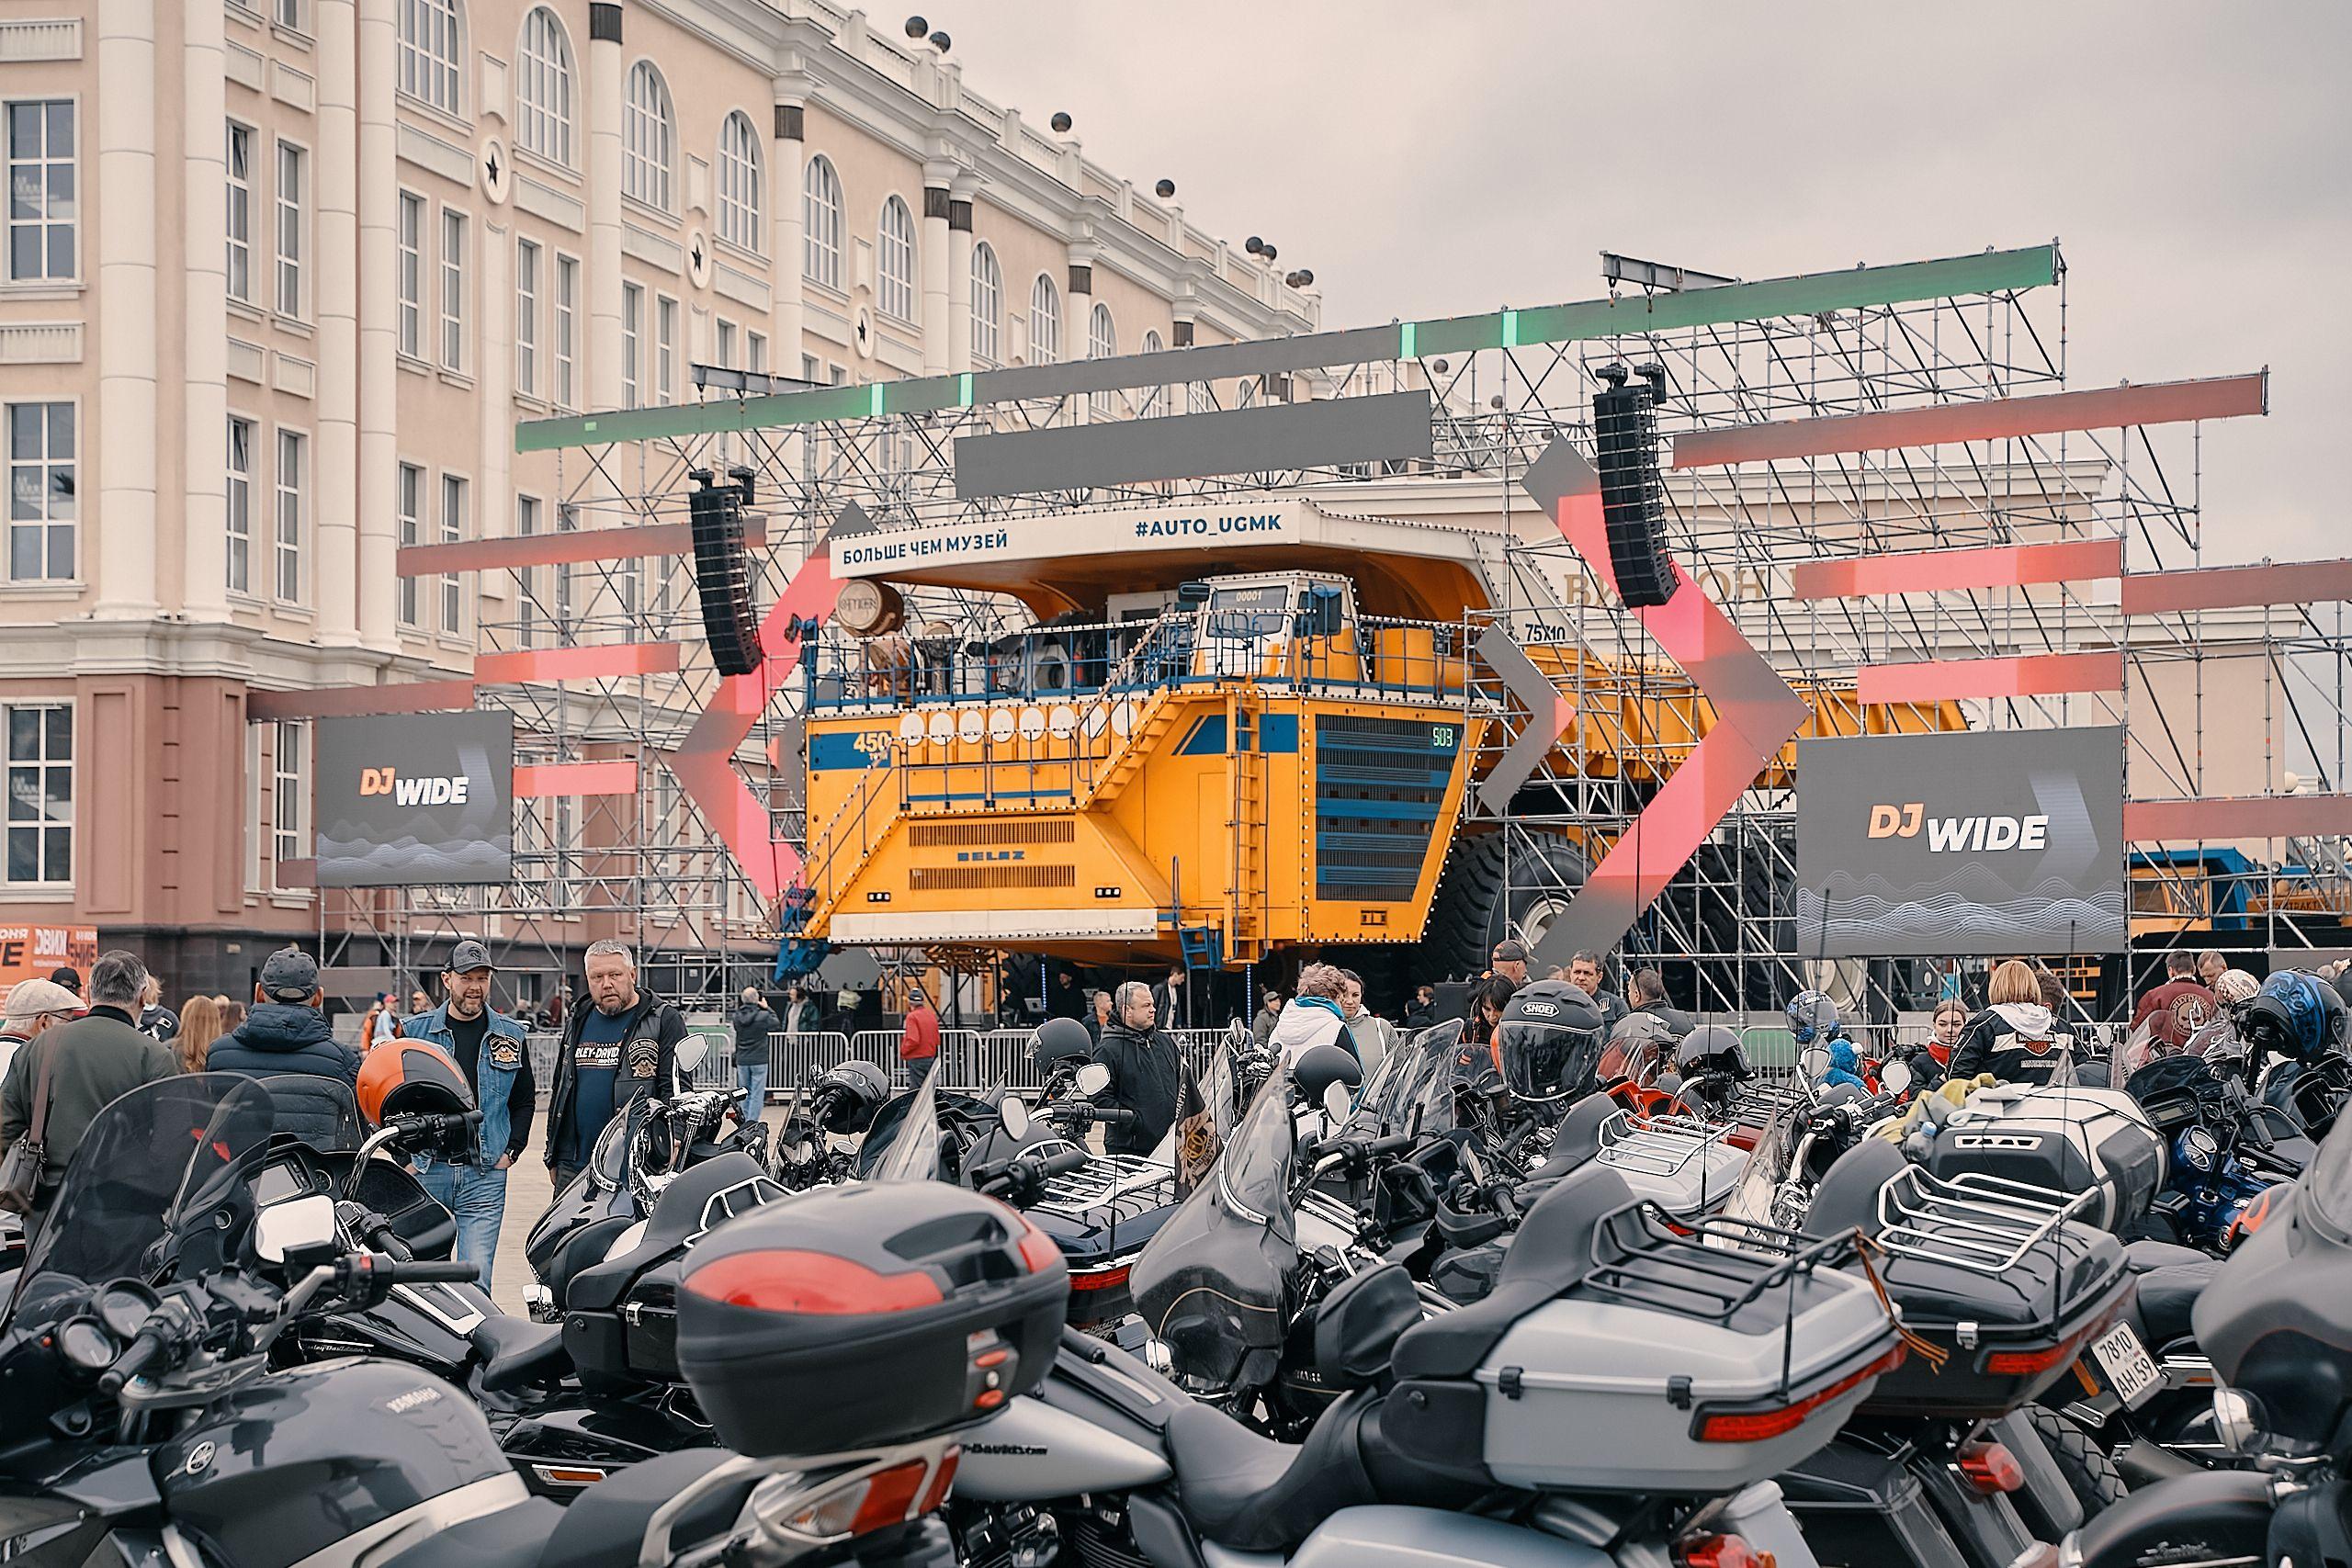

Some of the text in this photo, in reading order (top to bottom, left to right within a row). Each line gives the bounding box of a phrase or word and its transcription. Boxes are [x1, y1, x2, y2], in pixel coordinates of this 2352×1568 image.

[1136, 514, 1282, 537] #AUTO_UGMK
[843, 528, 1008, 565] БОЛЬШЕ ЧЕМ МУЗЕЙ
[1236, 591, 1262, 603] 00001
[853, 731, 891, 753] 450
[359, 766, 469, 807] DJ WIDE
[1867, 802, 2050, 852] DJ WIDE
[1525, 1004, 1555, 1015] SHOEI
[575, 1046, 620, 1059] RLEY-DAVID
[2099, 1330, 2132, 1365] 7810
[2132, 1357, 2154, 1382] 59
